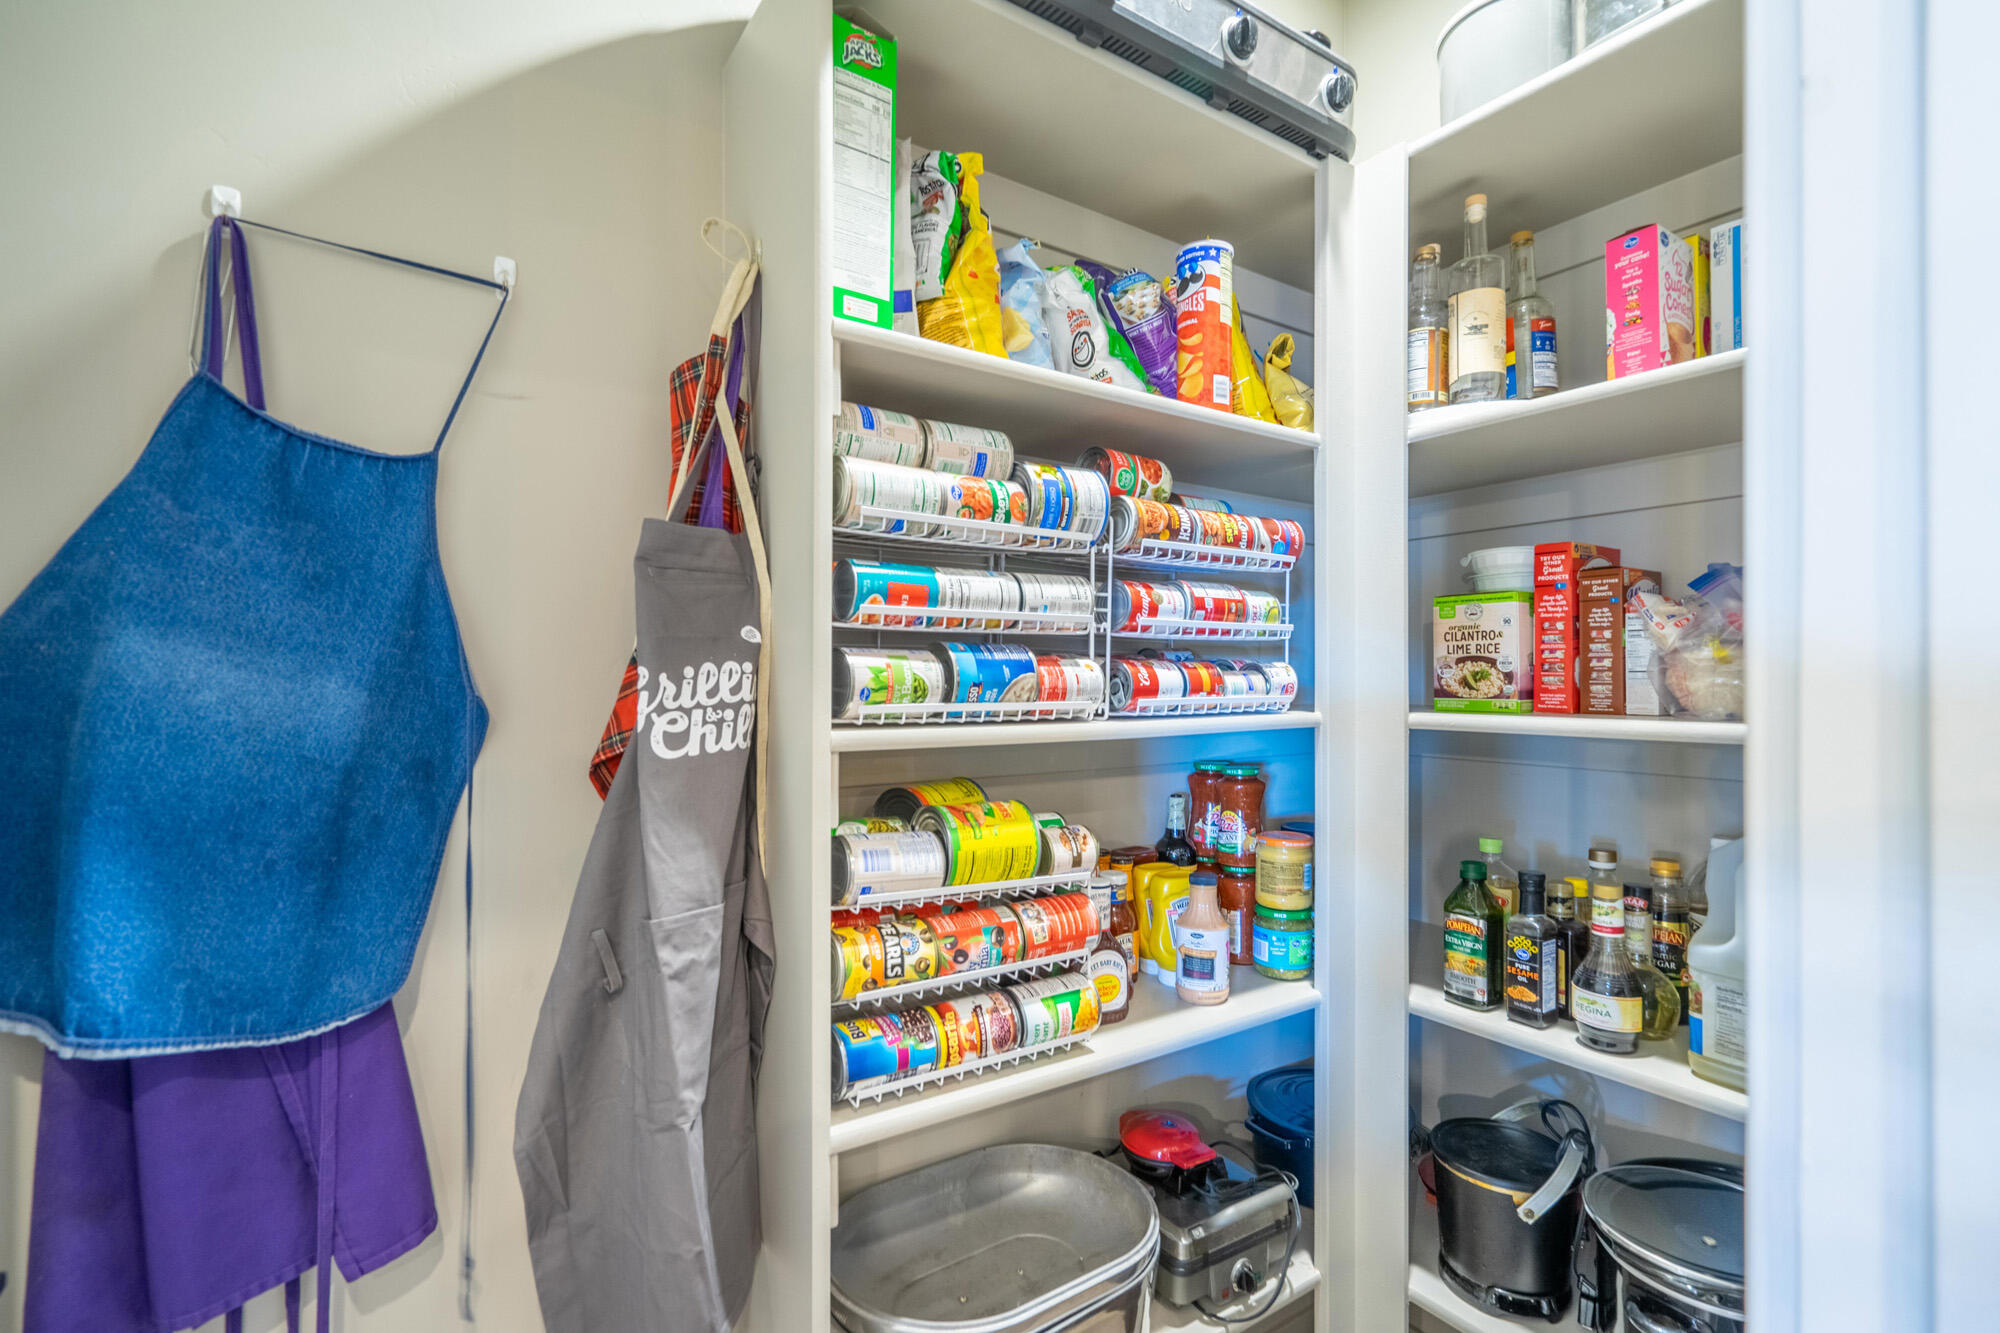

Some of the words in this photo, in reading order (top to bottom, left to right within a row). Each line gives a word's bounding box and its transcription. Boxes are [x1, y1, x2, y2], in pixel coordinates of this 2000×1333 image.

[843, 43, 881, 66] JACKS
[1676, 261, 1686, 276] 12
[1664, 271, 1693, 301] Sugar
[1543, 564, 1564, 575] Great
[1448, 623, 1481, 632] organic
[1444, 630, 1496, 642] CILANTRO
[1447, 643, 1471, 654] LIME
[1476, 643, 1500, 654] RICE
[705, 706, 723, 723] &
[1446, 919, 1481, 937] POMPEIAN
[878, 923, 903, 978] PEARLS
[1445, 935, 1462, 946] EXTRA
[1462, 939, 1483, 951] VIRGIN
[1507, 965, 1540, 981] SESAME
[1575, 1000, 1612, 1019] REGINA
